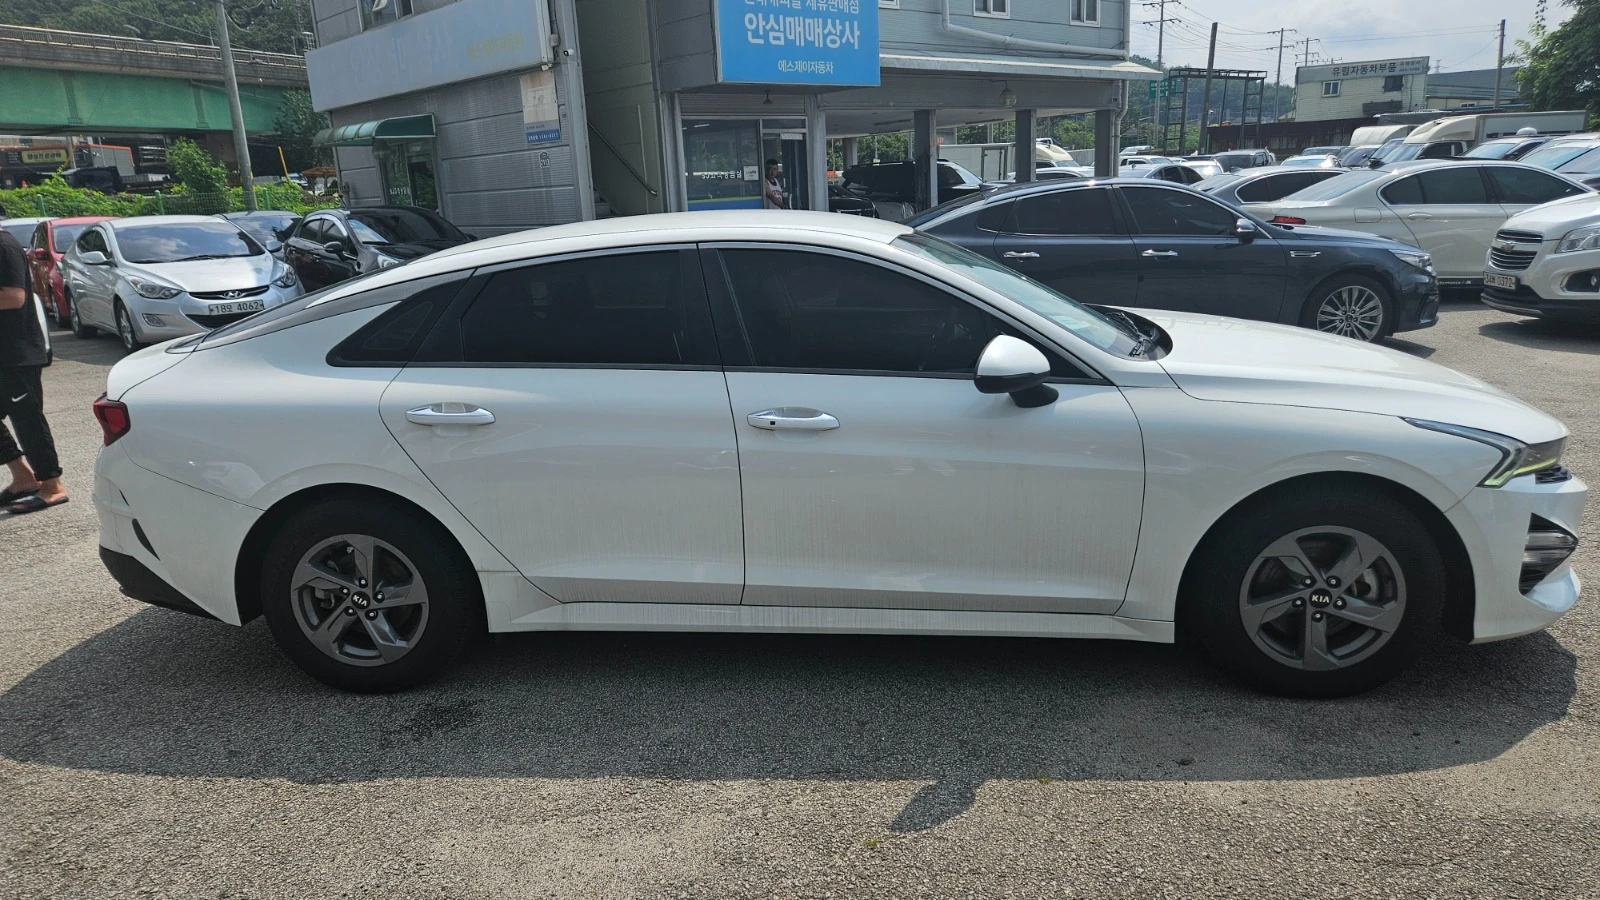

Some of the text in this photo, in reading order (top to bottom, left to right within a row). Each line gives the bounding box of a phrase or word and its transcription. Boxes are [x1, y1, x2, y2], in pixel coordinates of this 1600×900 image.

[744, 12, 861, 50] 안심매매상사
[777, 59, 834, 74] 에스제이자동차
[237, 301, 259, 312] 4062
[353, 595, 367, 606] KIA
[1312, 595, 1329, 603] KIA
